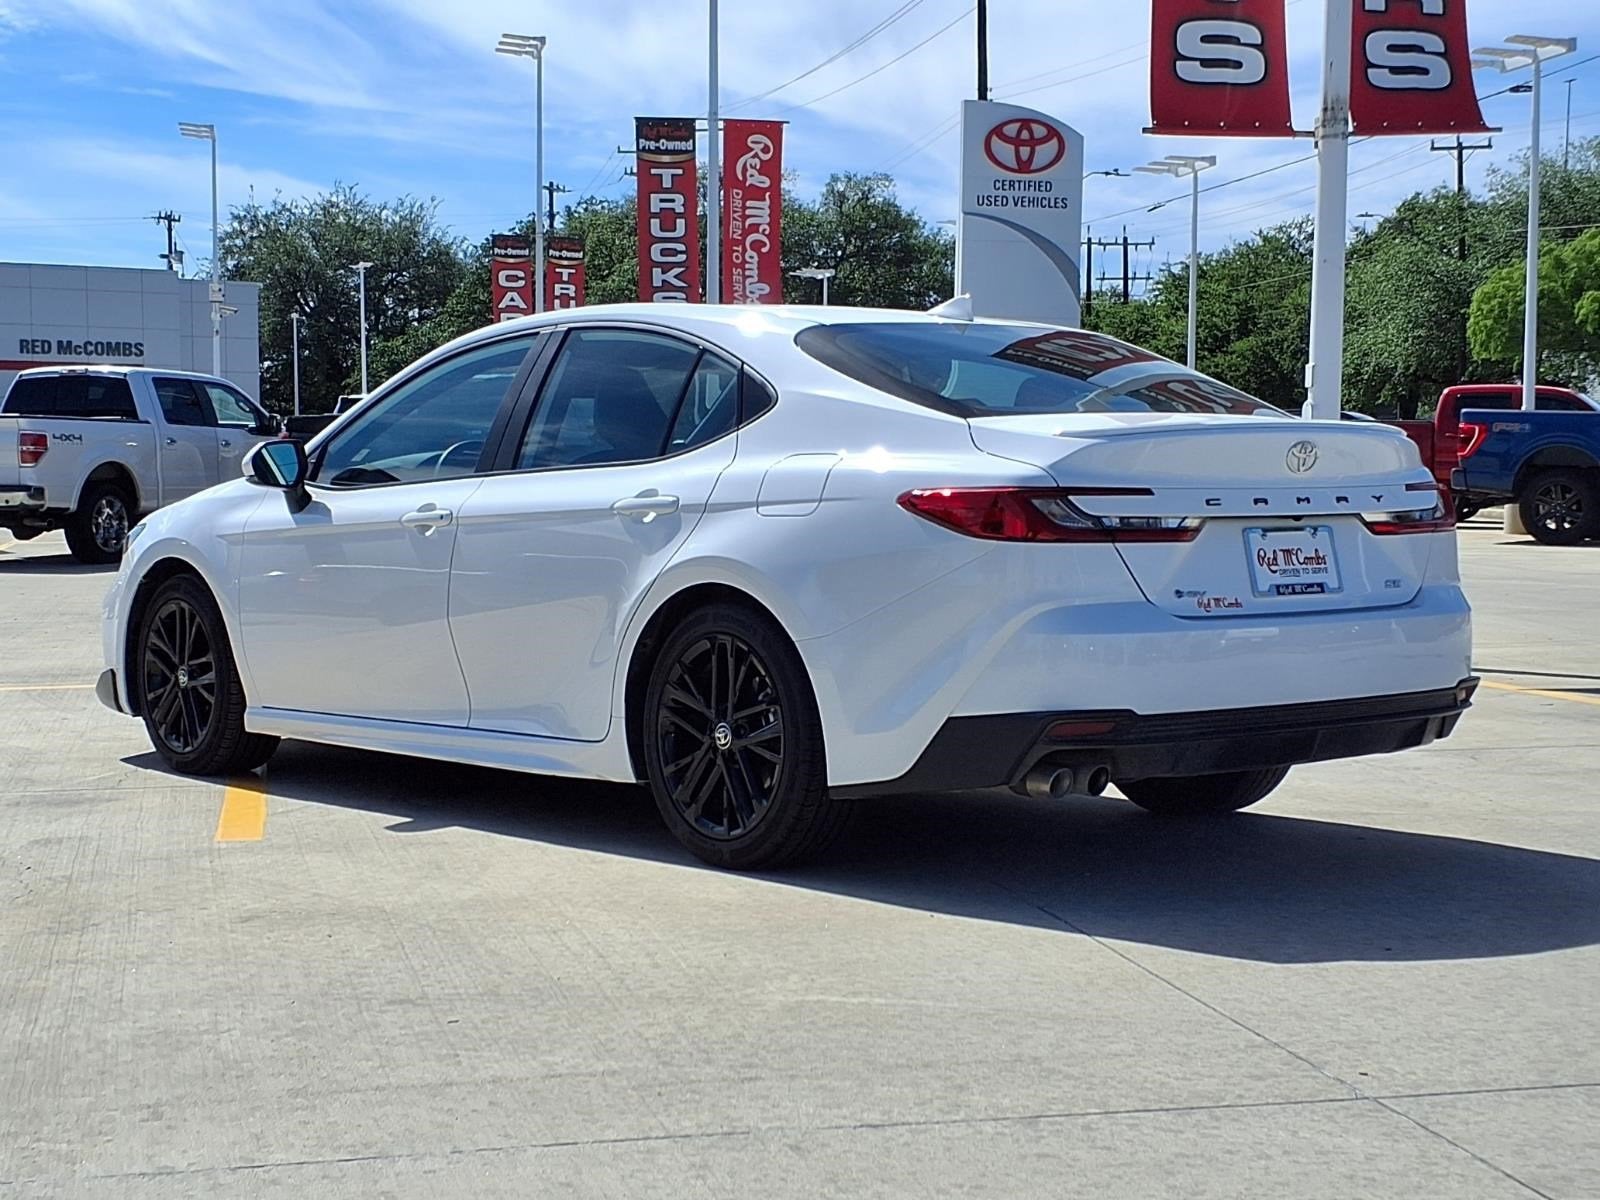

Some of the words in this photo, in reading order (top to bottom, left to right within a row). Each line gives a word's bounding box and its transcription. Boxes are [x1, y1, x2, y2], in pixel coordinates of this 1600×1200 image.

[1364, 0, 1452, 89] S
[638, 138, 693, 151] Pre-Owned
[736, 134, 774, 188] Red
[993, 179, 1053, 193] CERTIFIED
[976, 194, 1009, 207] USED
[1012, 195, 1069, 209] VEHICLES
[732, 188, 743, 239] DRIVEN
[493, 247, 530, 257] Pre-Owned
[548, 249, 584, 259] Pre-Owned
[732, 245, 743, 264] TO
[19, 338, 53, 355] RED
[56, 339, 145, 358] McCOMBS
[1204, 494, 1384, 507] CAMRY
[1256, 547, 1280, 574] Red
[1302, 567, 1311, 575] TO
[1311, 566, 1329, 575] SERVE
